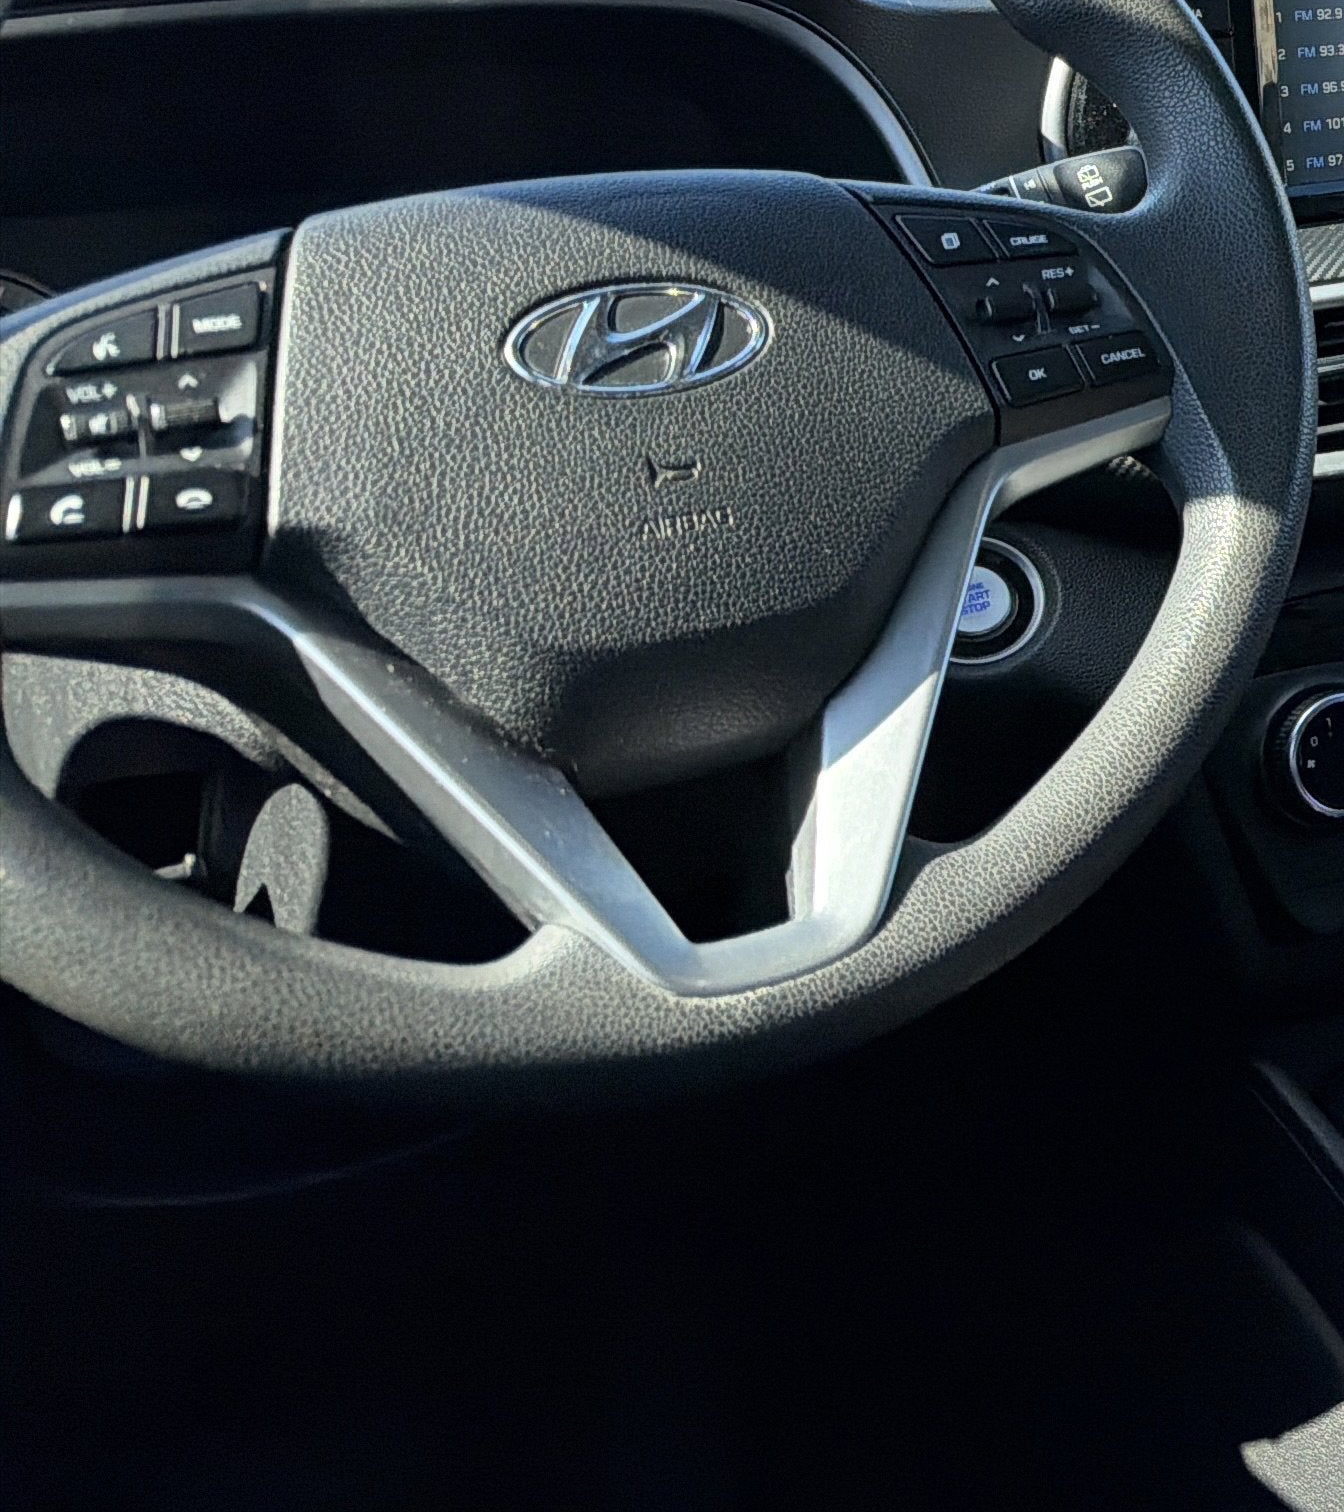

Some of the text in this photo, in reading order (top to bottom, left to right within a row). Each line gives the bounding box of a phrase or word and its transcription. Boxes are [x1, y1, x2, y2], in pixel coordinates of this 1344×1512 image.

[1276, 8, 1343, 23] 1 FM 92.9
[1278, 49, 1286, 61] 2
[1297, 47, 1316, 59] FM
[1280, 85, 1289, 97] 3
[1300, 83, 1319, 95] FM
[1282, 122, 1292, 135] 4
[1303, 120, 1322, 133] FM
[1286, 159, 1295, 171] 5
[1306, 156, 1325, 169] FM
[1100, 347, 1146, 365] CANCEL
[1028, 367, 1048, 381] OK
